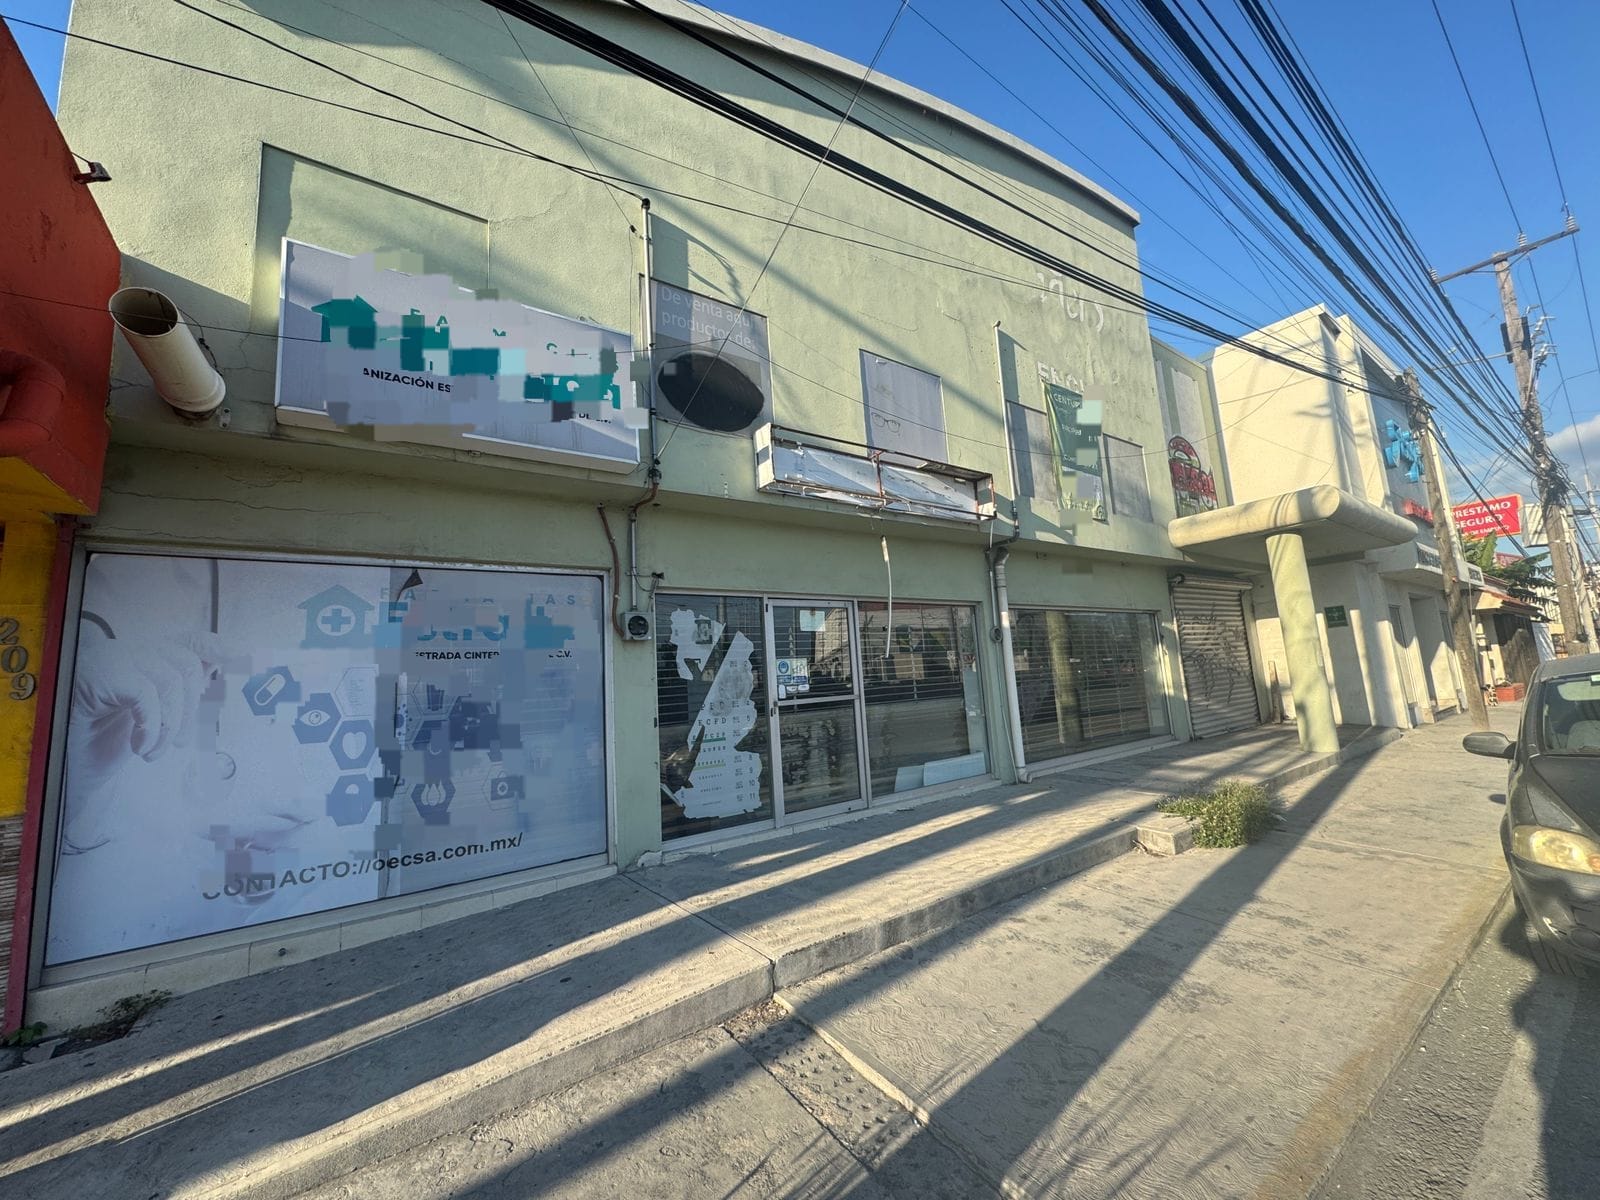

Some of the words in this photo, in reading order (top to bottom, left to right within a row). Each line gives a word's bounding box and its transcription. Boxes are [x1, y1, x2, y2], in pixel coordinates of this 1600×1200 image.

[661, 287, 681, 305] De
[685, 298, 723, 318] venta
[1455, 513, 1503, 529] SEGURO
